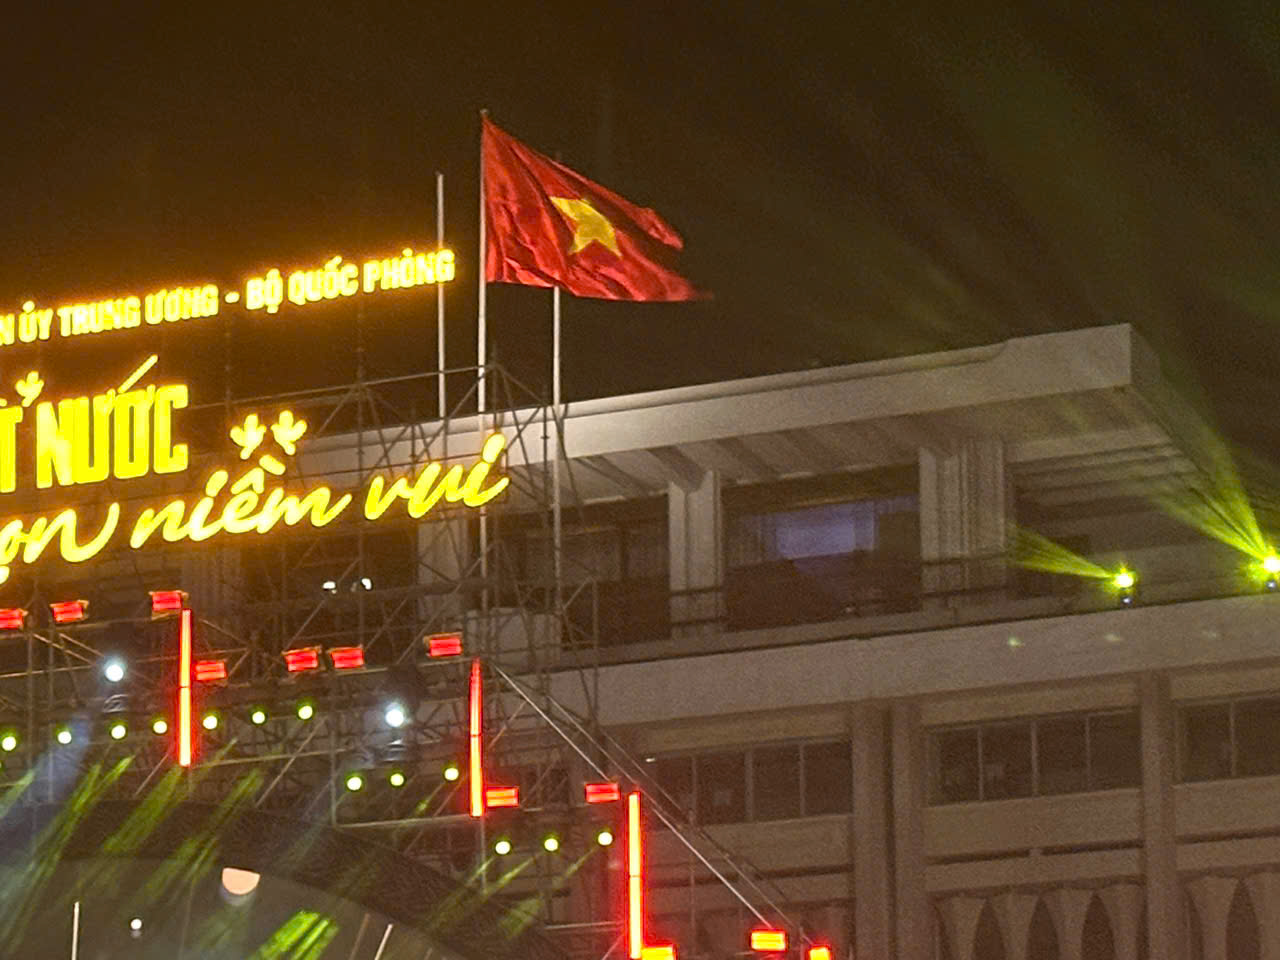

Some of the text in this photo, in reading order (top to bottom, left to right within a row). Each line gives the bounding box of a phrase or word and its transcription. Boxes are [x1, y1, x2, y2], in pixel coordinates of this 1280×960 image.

[56, 296, 142, 337] TRUNG
[288, 255, 359, 306] QUỐC
[36, 354, 189, 489] NƯỚC
[130, 453, 353, 549] niềm
[365, 432, 511, 521] vui
